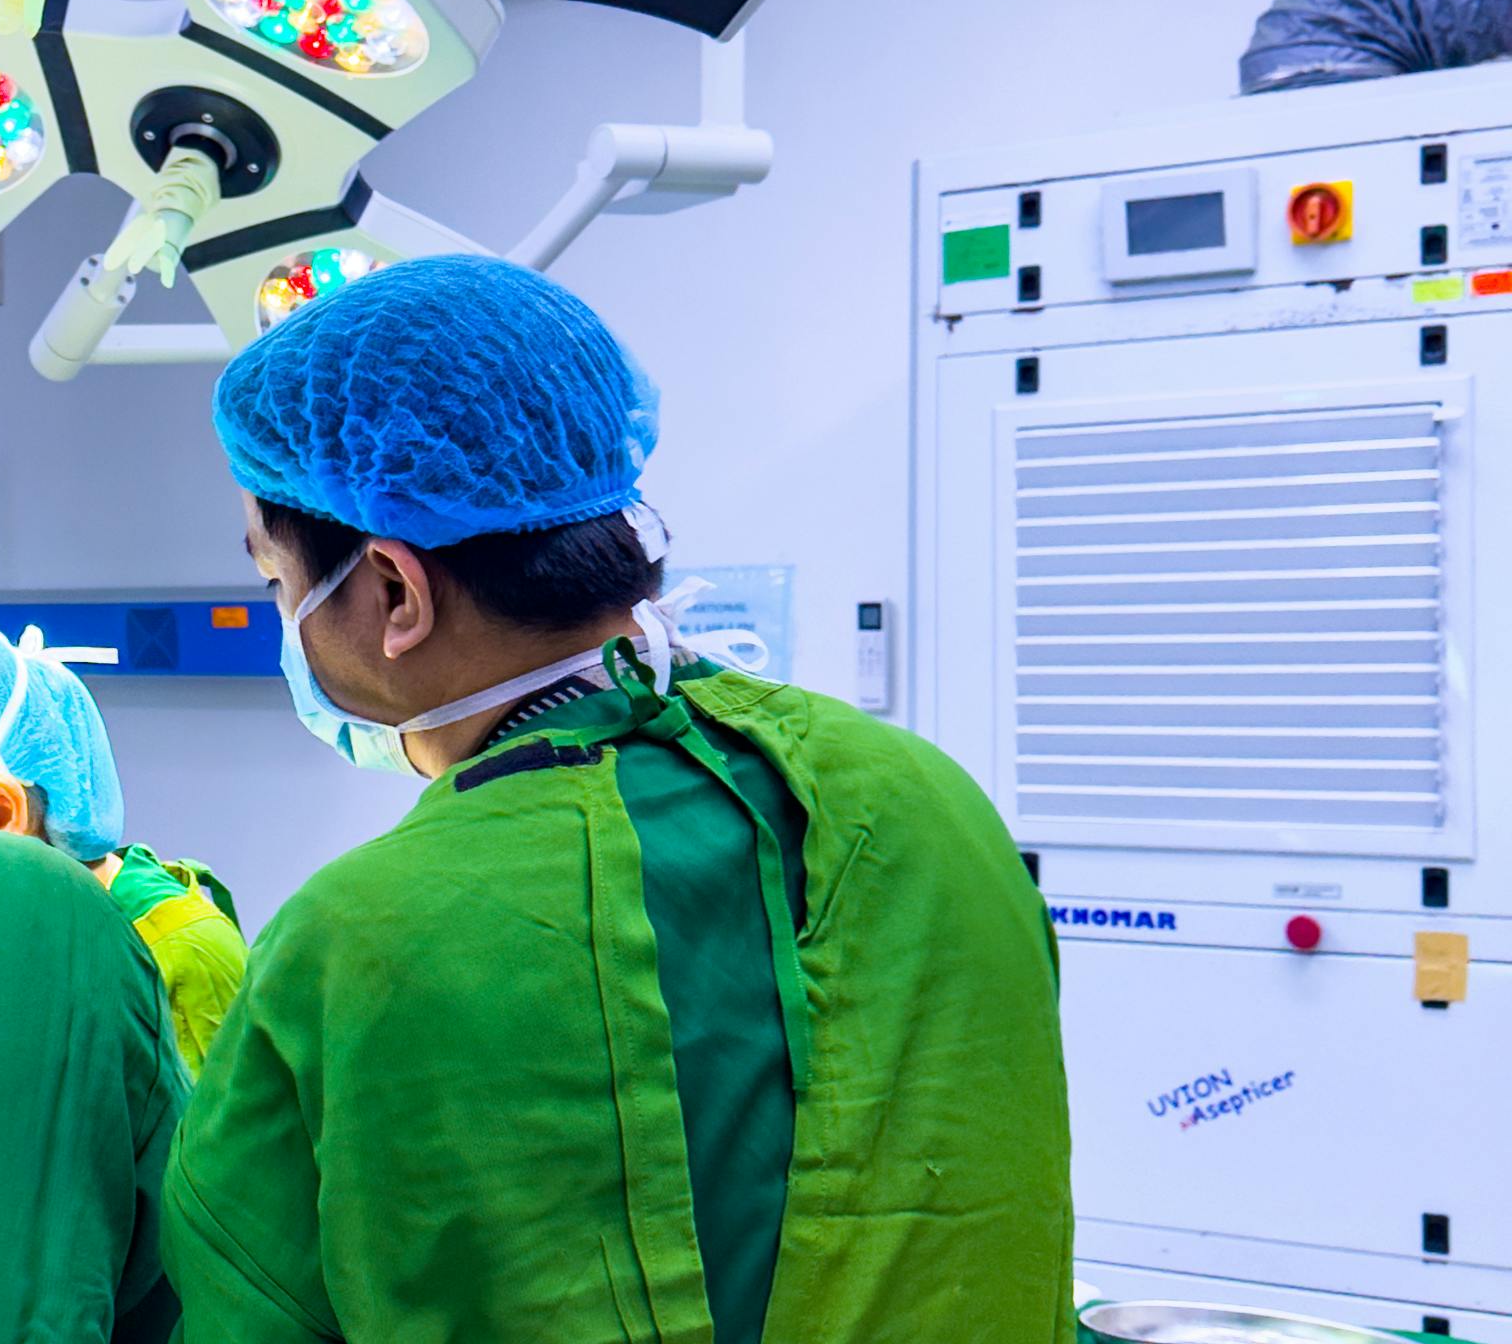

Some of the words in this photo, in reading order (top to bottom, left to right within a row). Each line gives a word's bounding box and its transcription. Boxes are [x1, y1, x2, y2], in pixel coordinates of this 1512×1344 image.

[1050, 906, 1177, 929] KNOMAR
[1147, 1068, 1233, 1117] UVION
[1191, 1070, 1294, 1125] Asepticer
